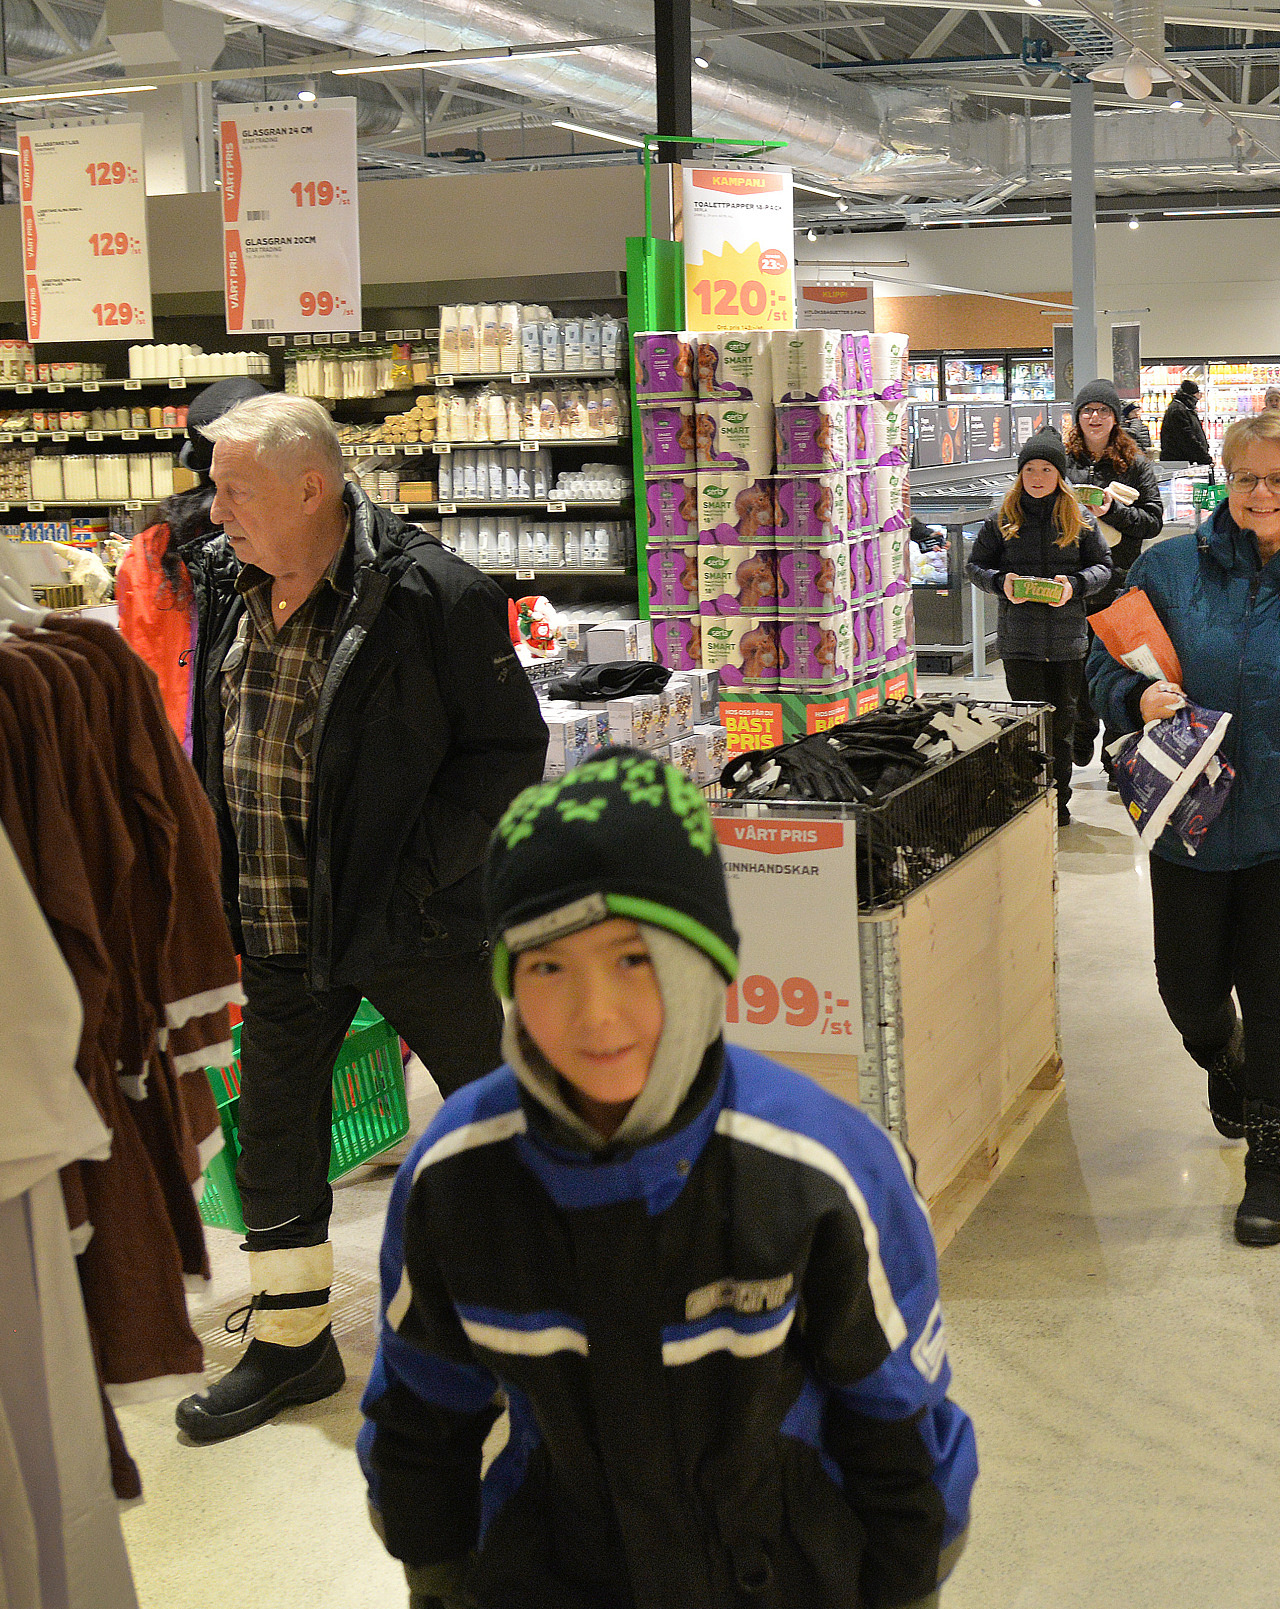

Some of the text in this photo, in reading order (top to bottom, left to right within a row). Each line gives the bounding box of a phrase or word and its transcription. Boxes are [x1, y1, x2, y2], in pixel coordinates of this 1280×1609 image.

[242, 127, 287, 138] GLASGRAN
[225, 142, 235, 200] VÅRT PRIS
[694, 201, 754, 210] TOALETTPAPPER
[245, 237, 292, 246] GLASGRAN
[229, 251, 239, 308] VÅRT PRIS
[767, 308, 787, 321] /st
[724, 356, 753, 364] SMART
[704, 572, 732, 580] SMART
[726, 717, 774, 733] BÄST
[726, 734, 774, 751] PRIS
[734, 825, 818, 843] VÅRT PRIS
[723, 862, 819, 875] KINNHANDSKAR
[820, 1017, 853, 1035] /st
